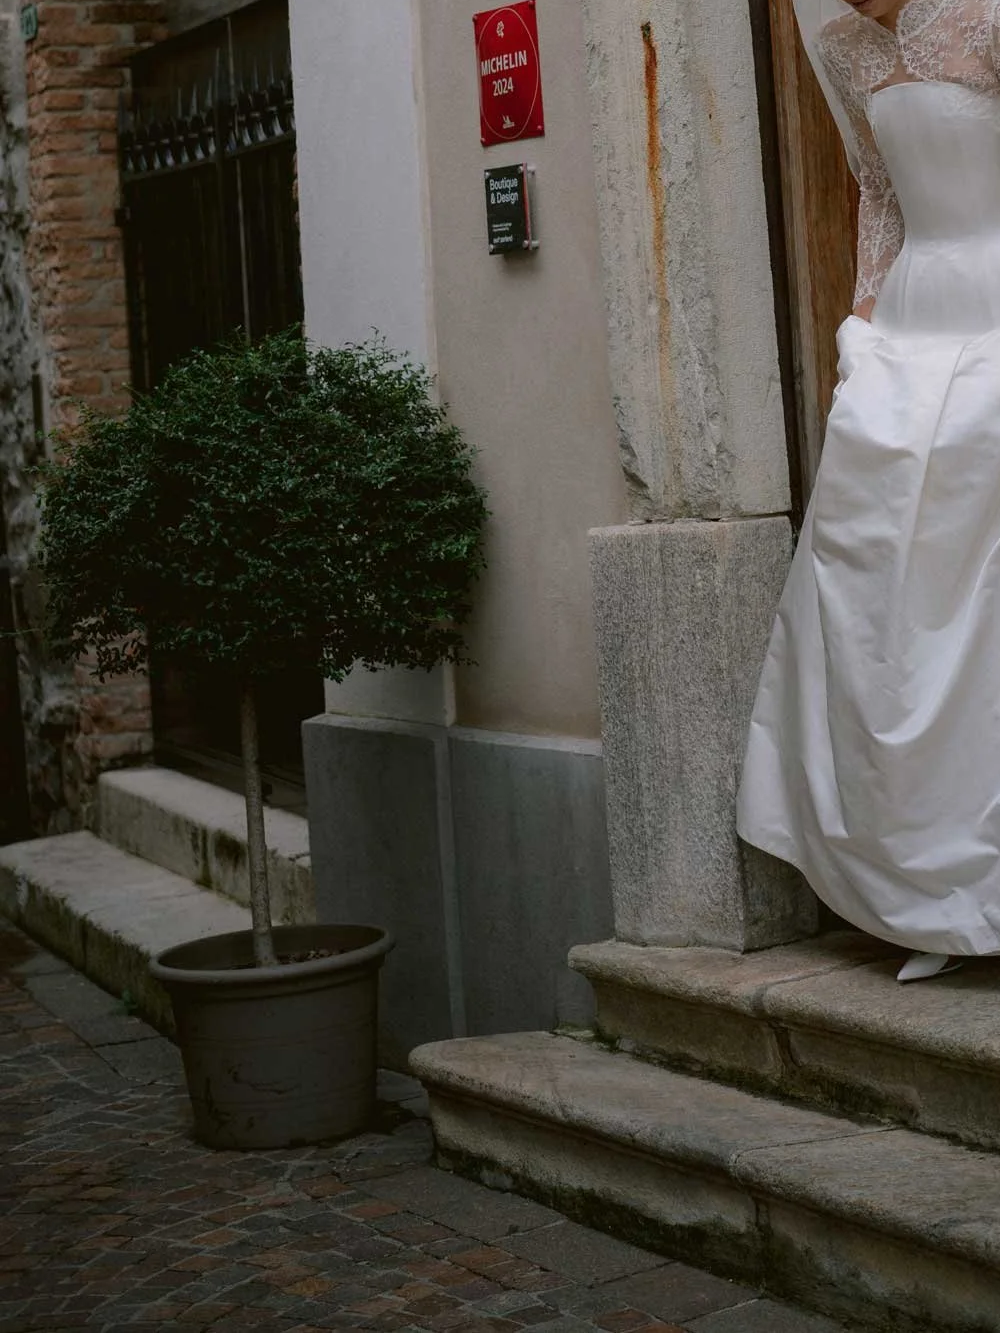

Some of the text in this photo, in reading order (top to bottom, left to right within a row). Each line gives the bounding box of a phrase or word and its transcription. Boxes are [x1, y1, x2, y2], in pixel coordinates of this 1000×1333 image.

[480, 50, 527, 77] MICHELIN
[492, 77, 514, 97] 2024
[489, 177, 518, 191] Boutique
[490, 191, 519, 204] & Design
